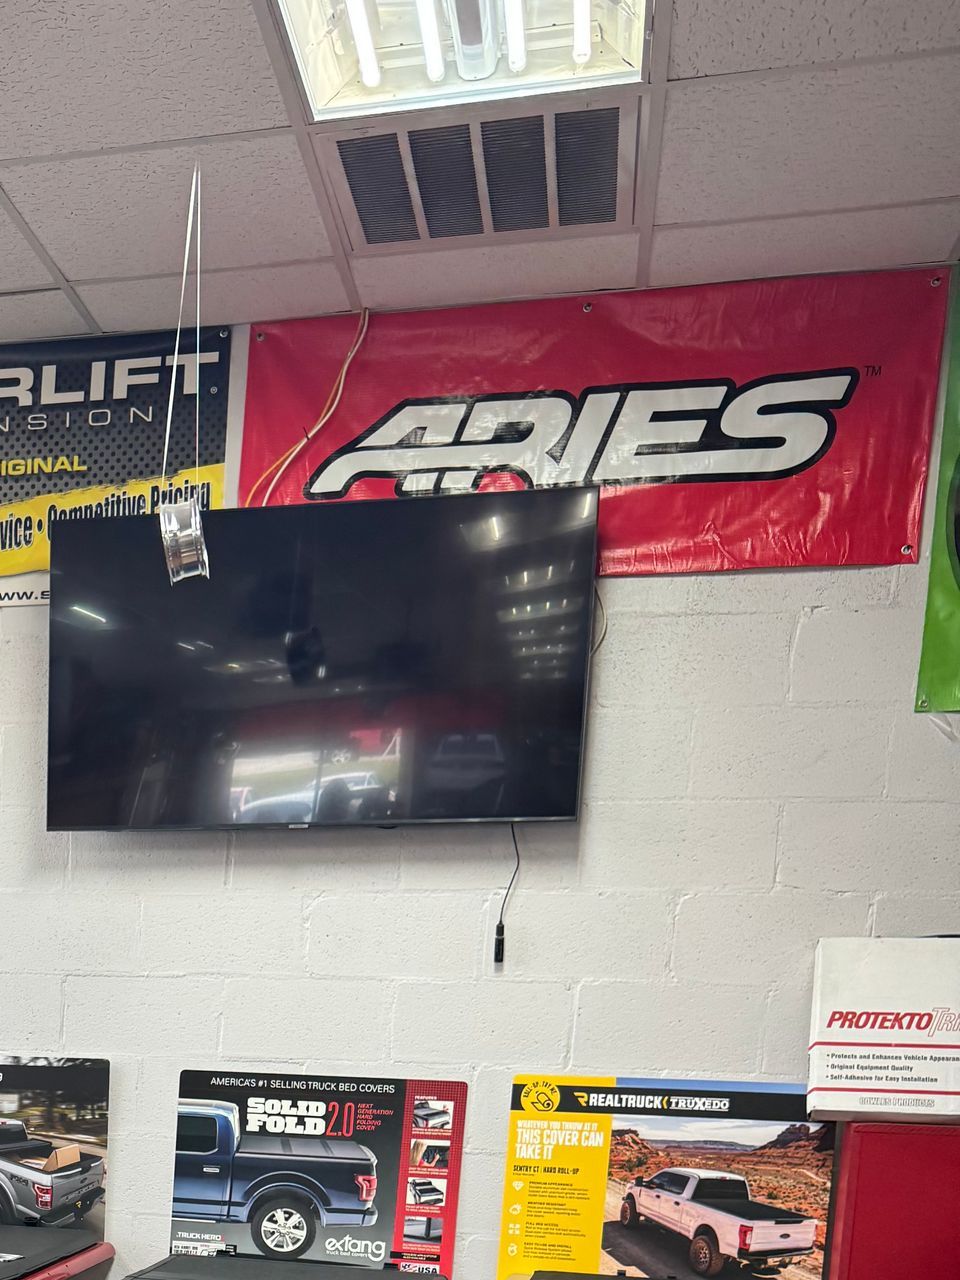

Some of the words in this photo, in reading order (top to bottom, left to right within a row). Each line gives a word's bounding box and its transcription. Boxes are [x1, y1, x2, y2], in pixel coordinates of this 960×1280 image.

[303, 367, 860, 498] ARIES
[830, 1063, 855, 1071] Original
[210, 1076, 257, 1087] AMERICA'S
[258, 1079, 269, 1088] #1
[270, 1079, 306, 1090] SELLING
[307, 1081, 337, 1092] TRUCK
[339, 1082, 357, 1093] BED
[359, 1083, 395, 1094] COVERS
[245, 1097, 327, 1117] SOLID
[589, 1093, 662, 1109] REALTRUCK
[245, 1115, 327, 1136] FOLD
[326, 1101, 355, 1137] 2.0
[517, 1129, 540, 1144] THIS
[543, 1129, 579, 1146] COVER
[581, 1131, 604, 1147] CAN
[515, 1143, 540, 1159] TAKE
[543, 1144, 554, 1159] IT
[325, 1233, 386, 1261] extang
[418, 1266, 438, 1274] USA
